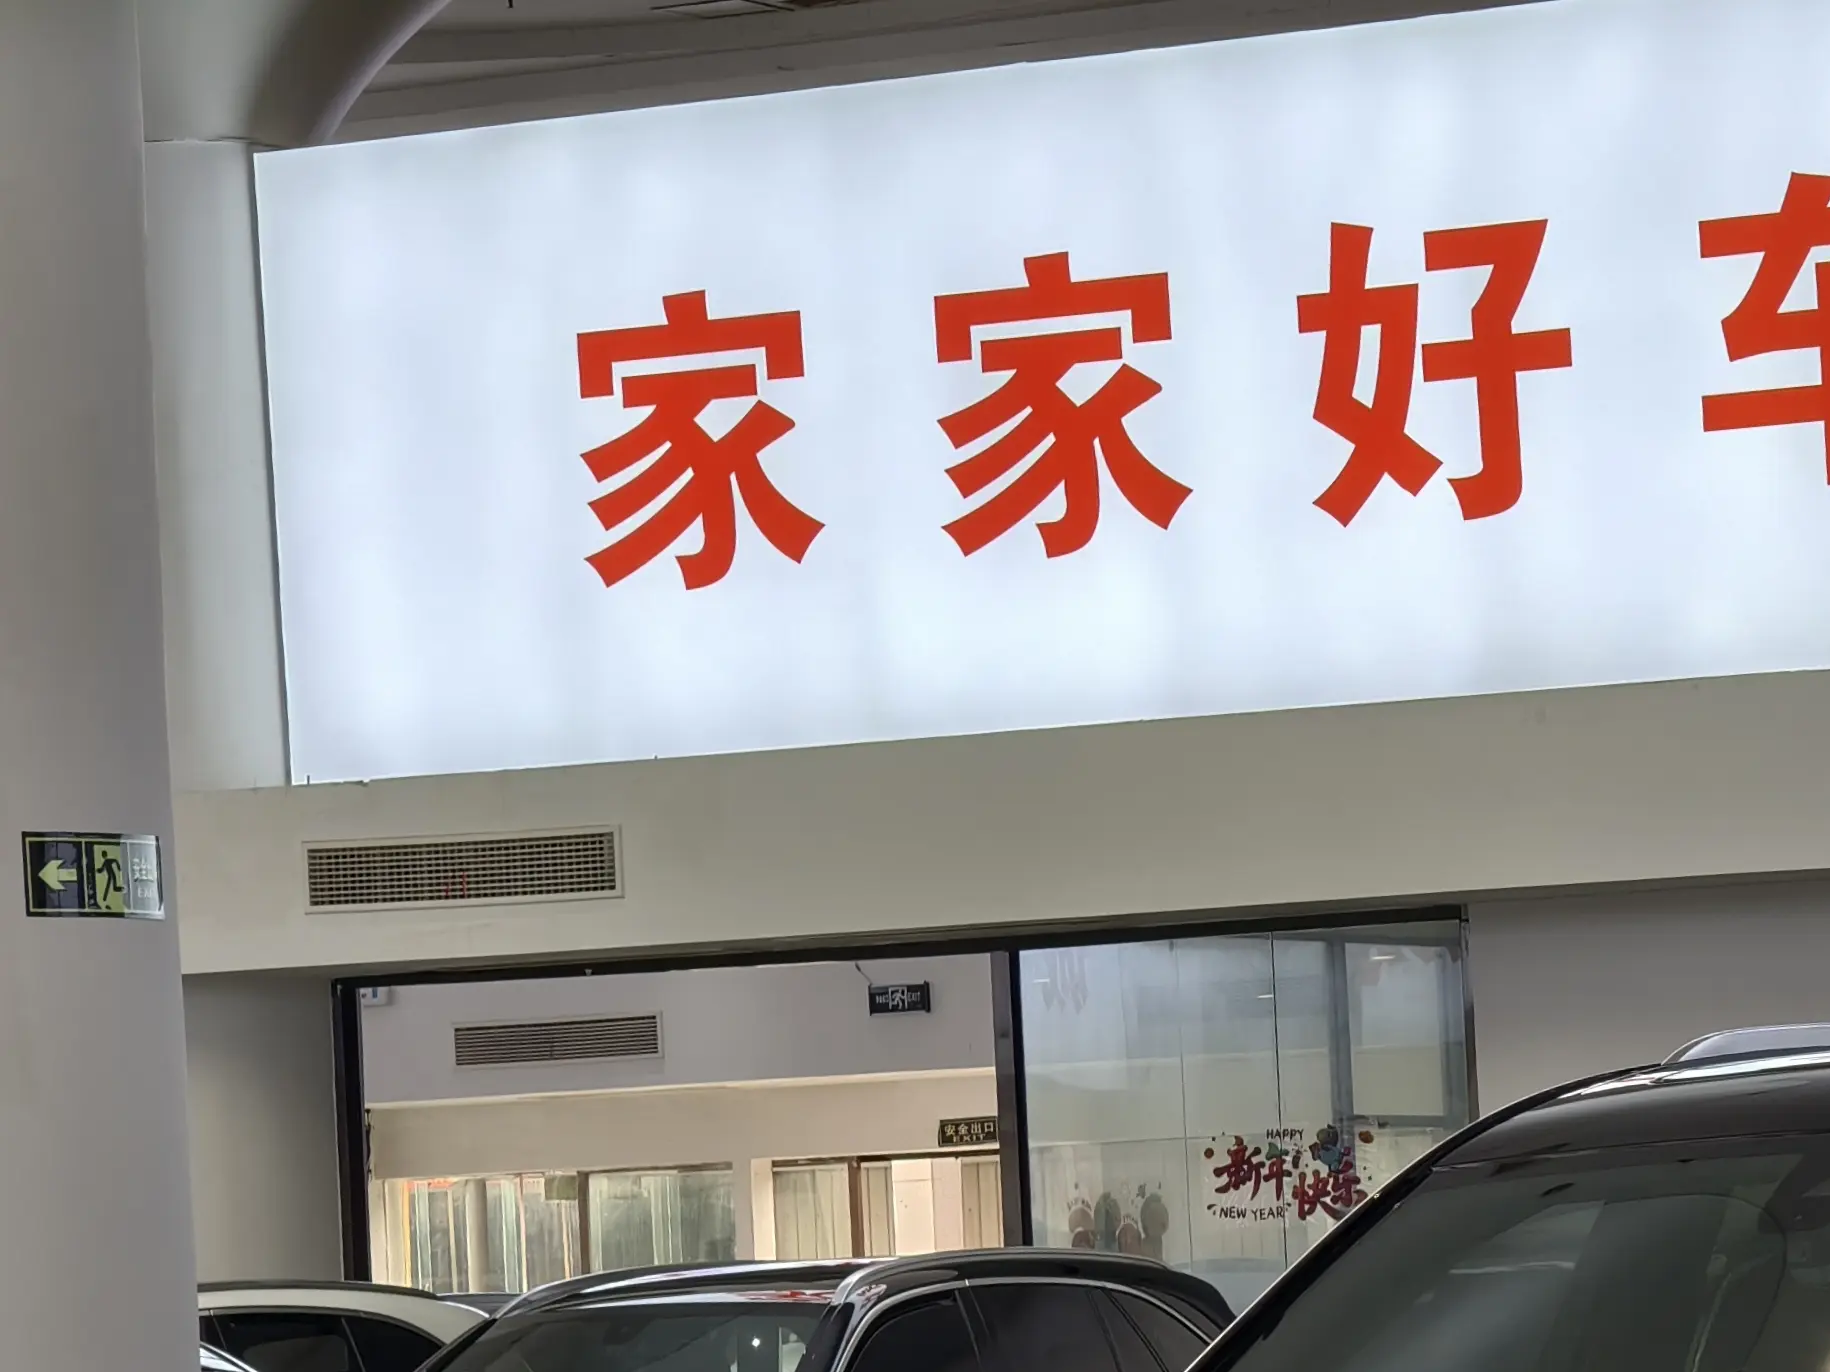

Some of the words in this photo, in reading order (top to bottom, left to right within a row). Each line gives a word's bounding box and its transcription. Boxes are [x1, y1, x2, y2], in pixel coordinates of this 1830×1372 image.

[944, 1121, 994, 1137] 安全出口
[1266, 1128, 1305, 1141] HAPPY
[1219, 1206, 1247, 1219] NEW
[1251, 1206, 1285, 1221] YEAR
